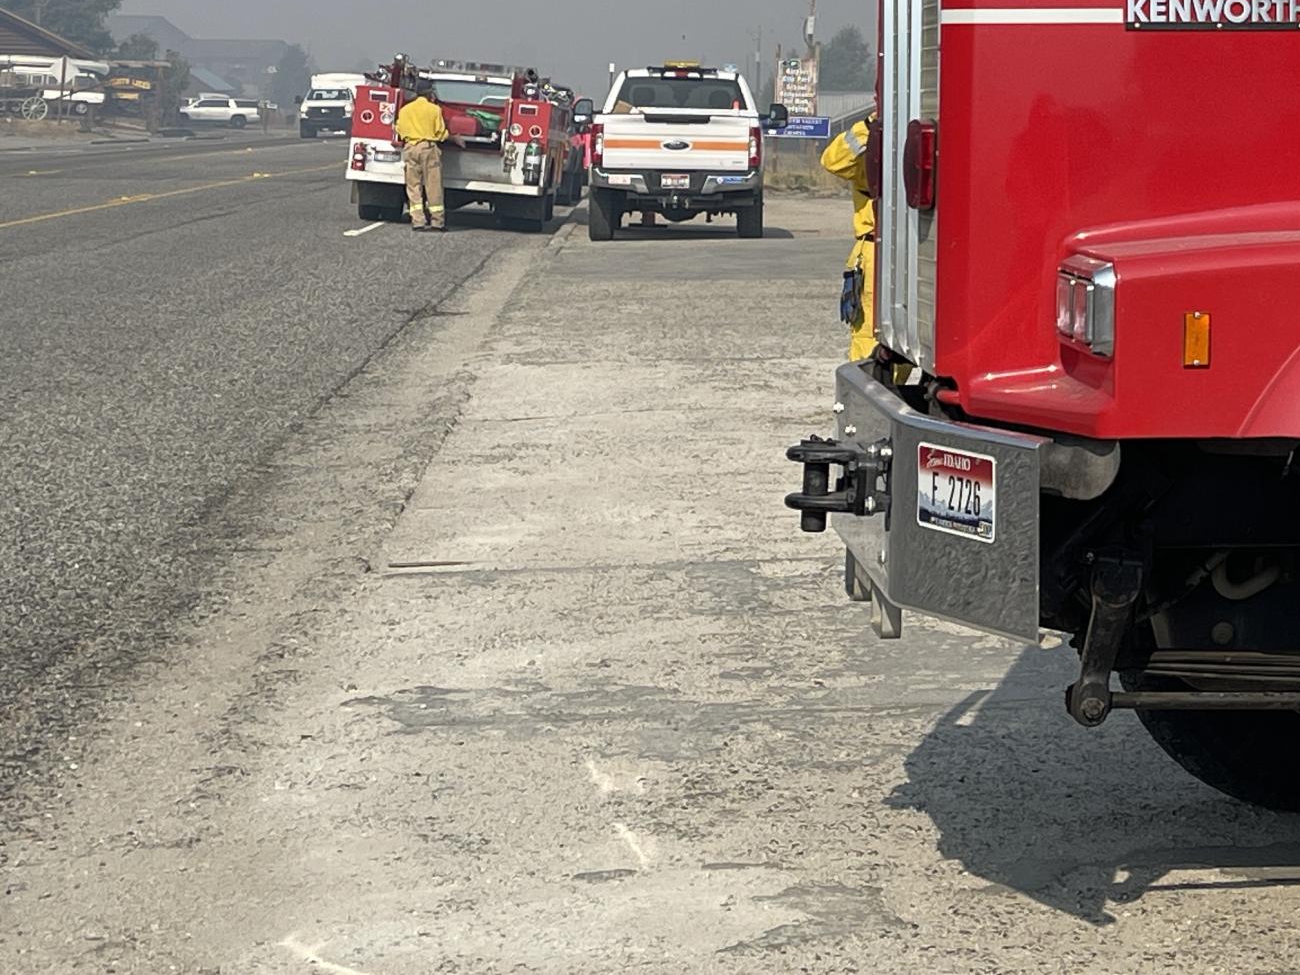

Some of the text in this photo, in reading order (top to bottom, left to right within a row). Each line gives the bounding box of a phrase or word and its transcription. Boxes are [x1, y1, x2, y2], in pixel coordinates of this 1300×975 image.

[943, 454, 971, 471] IDAHO
[931, 472, 981, 517] F 2726
